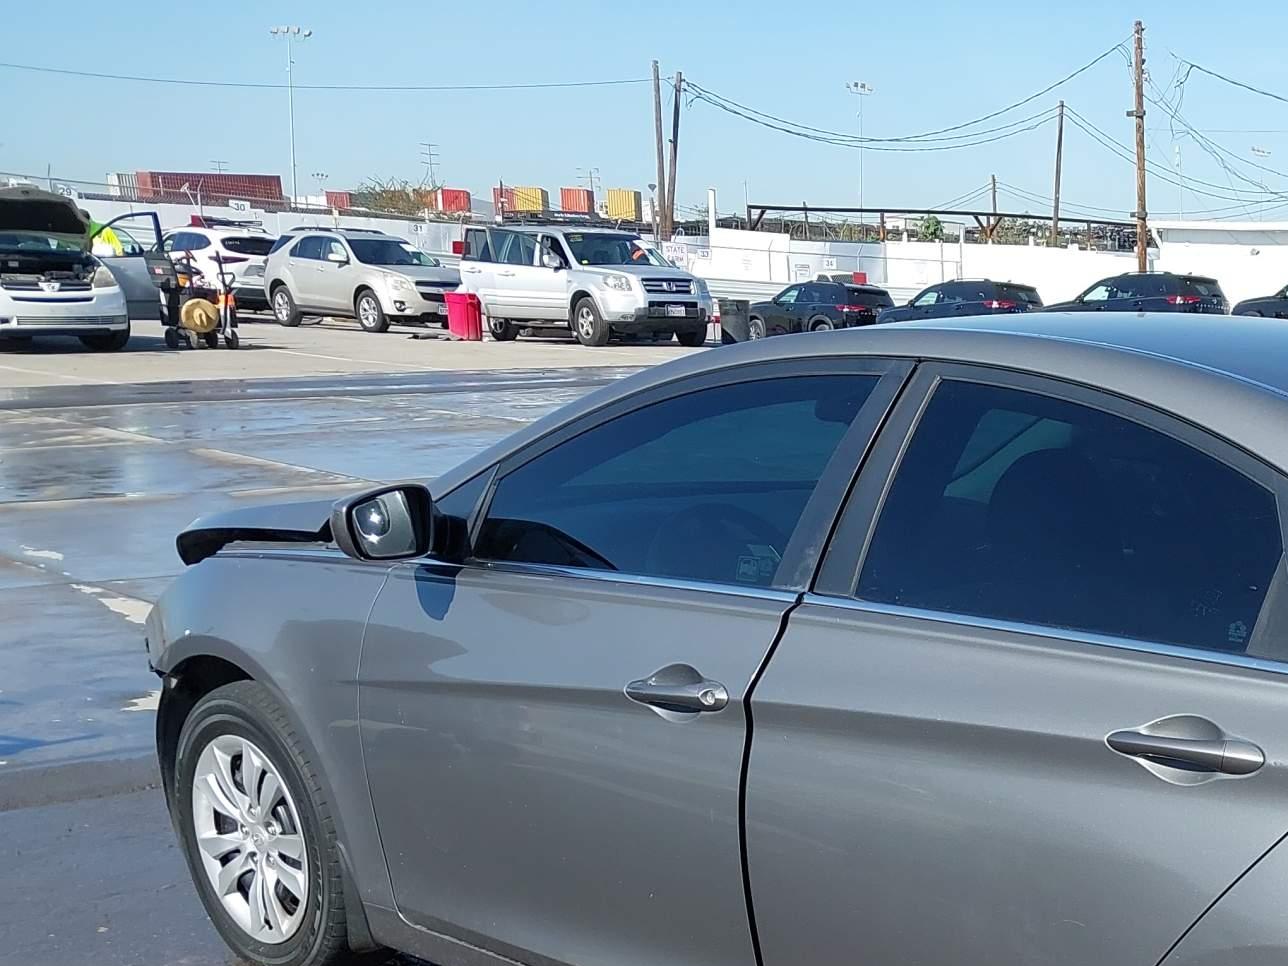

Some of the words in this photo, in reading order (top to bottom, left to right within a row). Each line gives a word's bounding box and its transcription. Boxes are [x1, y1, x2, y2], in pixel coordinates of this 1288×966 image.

[59, 186, 72, 196] 29
[234, 202, 246, 212] 30
[413, 224, 423, 232] 31
[665, 245, 685, 254] STATE
[825, 259, 834, 267] 34
